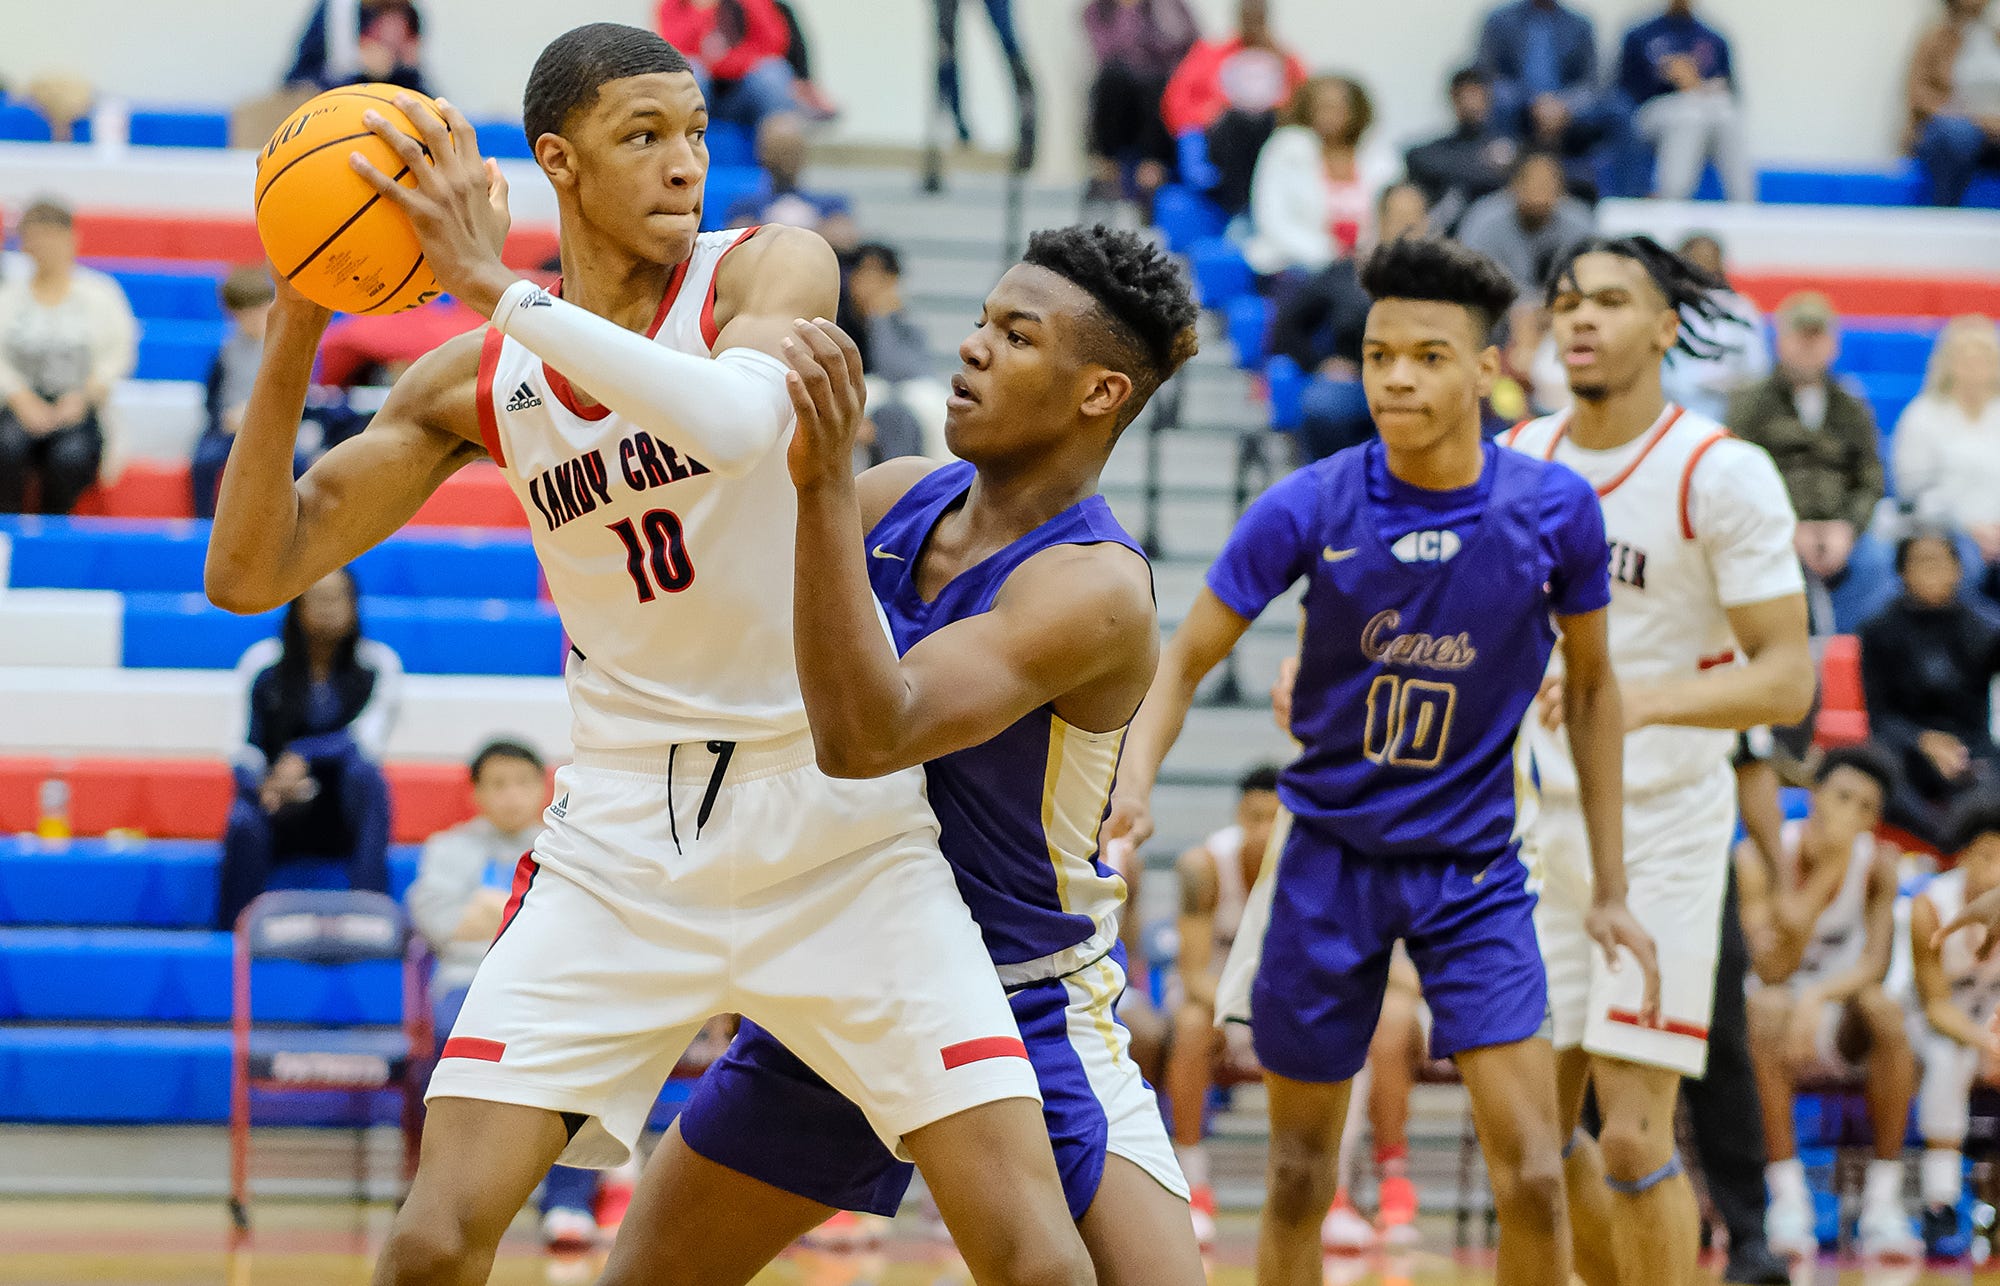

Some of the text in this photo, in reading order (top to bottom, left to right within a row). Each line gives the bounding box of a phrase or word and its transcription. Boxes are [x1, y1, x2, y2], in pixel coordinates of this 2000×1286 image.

[506, 398, 542, 412] adidas
[619, 431, 711, 491] CRE
[605, 508, 695, 603] 10
[1360, 609, 1477, 671] Canes
[1363, 675, 1457, 768] 10
